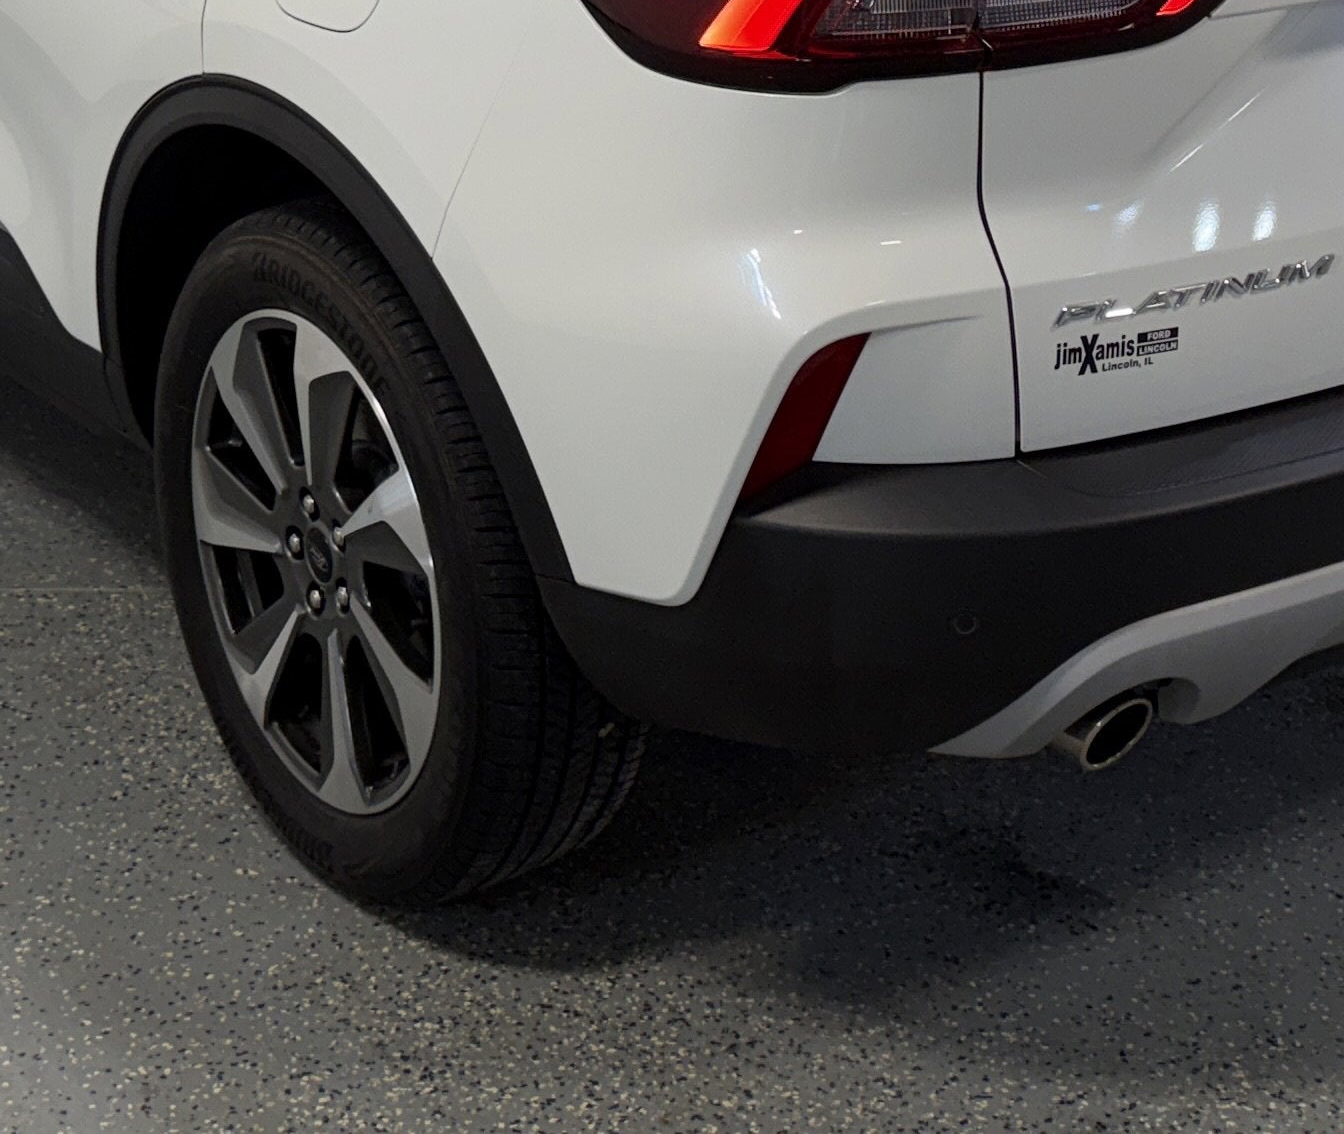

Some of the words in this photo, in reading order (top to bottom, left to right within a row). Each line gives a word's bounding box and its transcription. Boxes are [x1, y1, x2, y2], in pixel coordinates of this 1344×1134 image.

[1053, 253, 1336, 328] PLATINUM
[1147, 330, 1171, 341] FORD
[1138, 341, 1177, 356] LINCOLN
[1102, 359, 1141, 372] Lincoln,
[1144, 357, 1154, 365] IL
